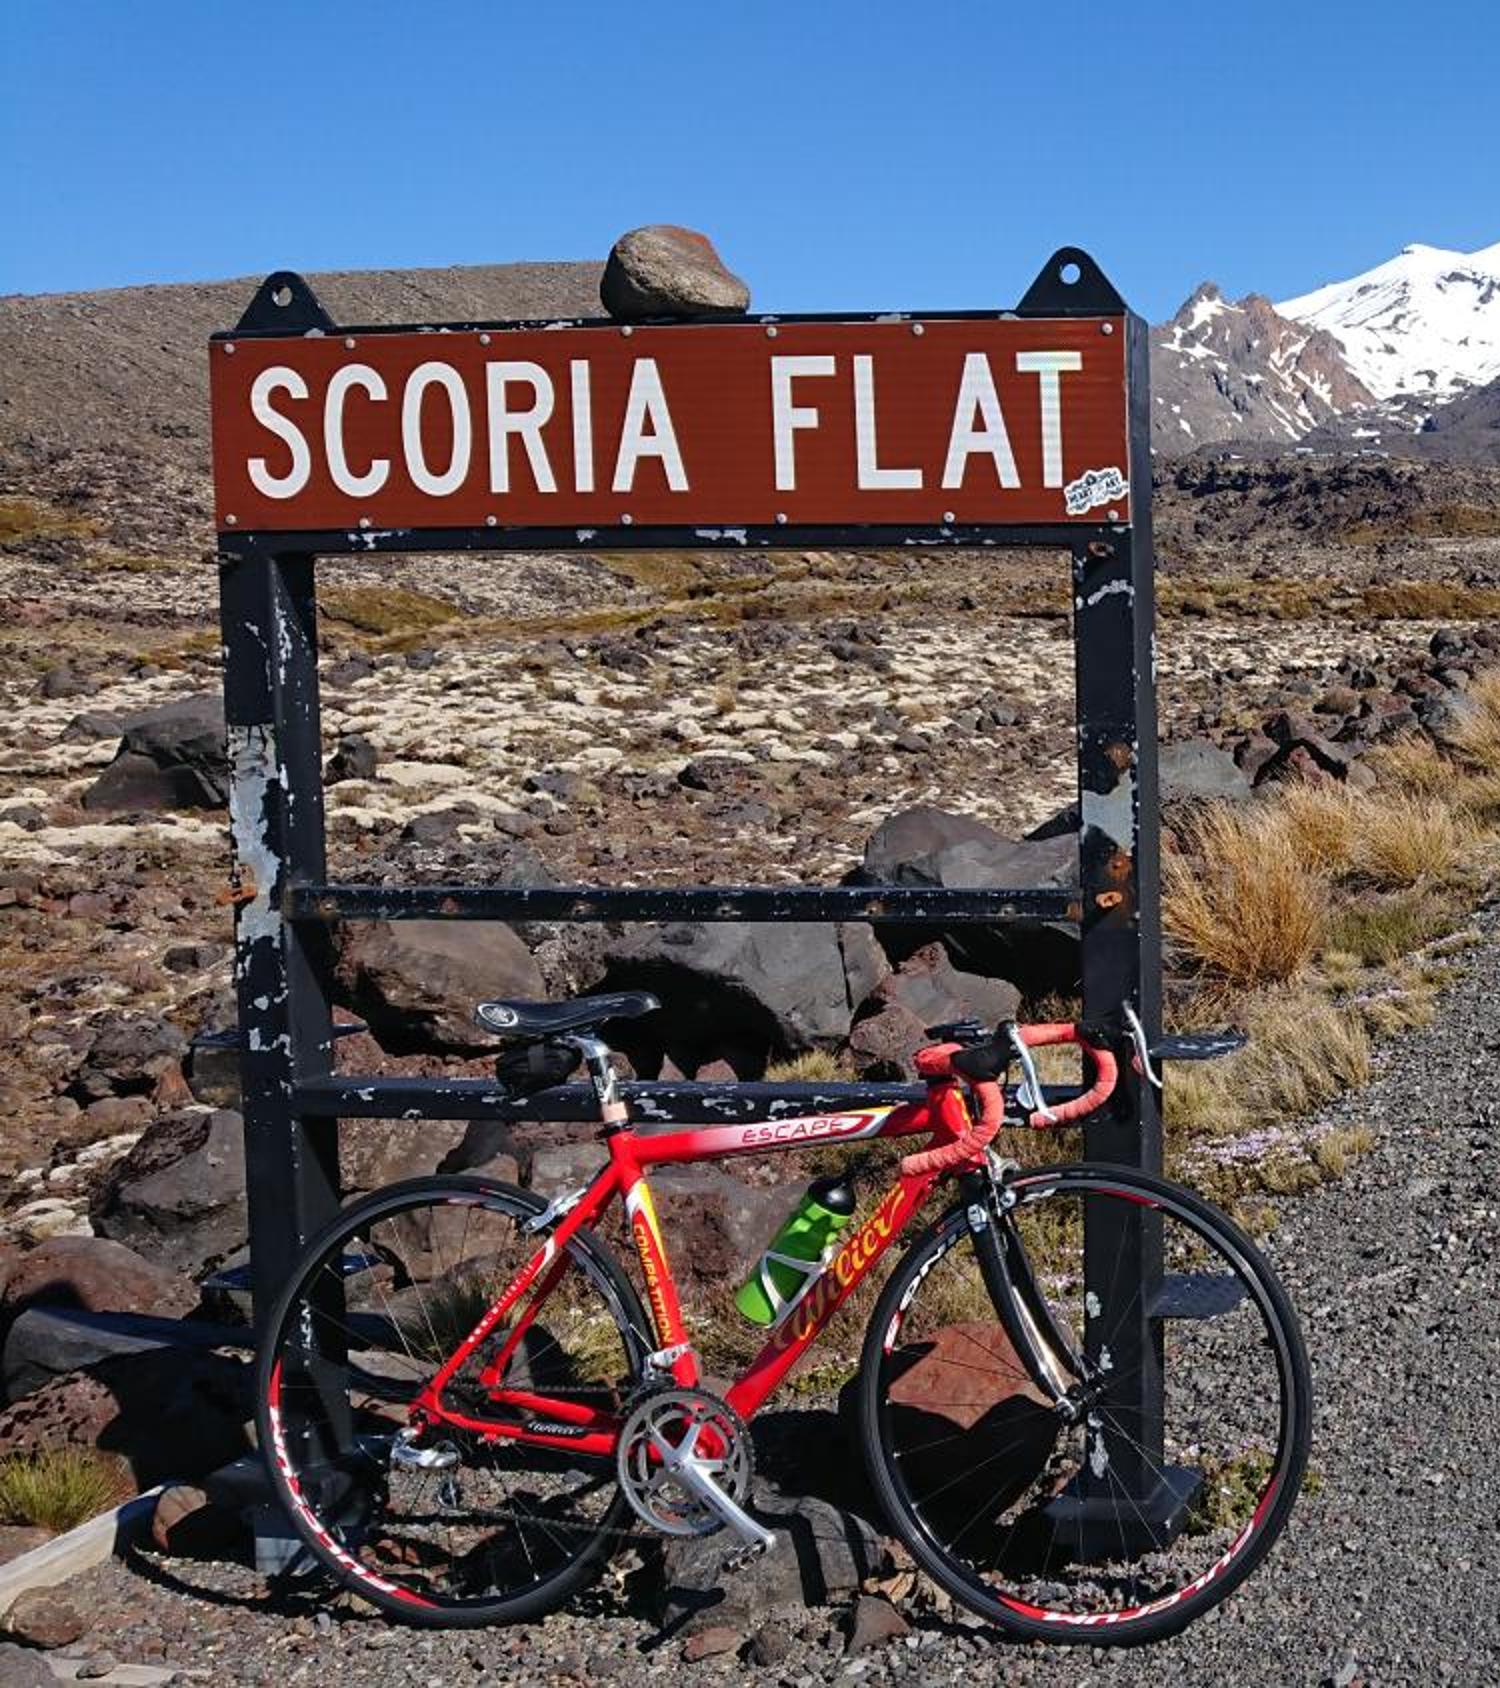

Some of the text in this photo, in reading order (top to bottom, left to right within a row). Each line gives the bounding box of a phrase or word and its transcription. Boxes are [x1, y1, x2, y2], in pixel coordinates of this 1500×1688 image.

[247, 350, 1083, 499] SCORIA FLAT
[742, 1118, 844, 1144] ESCAPE
[633, 1223, 675, 1343] COMPETITION
[1042, 1520, 1254, 1625] FULCRUM
